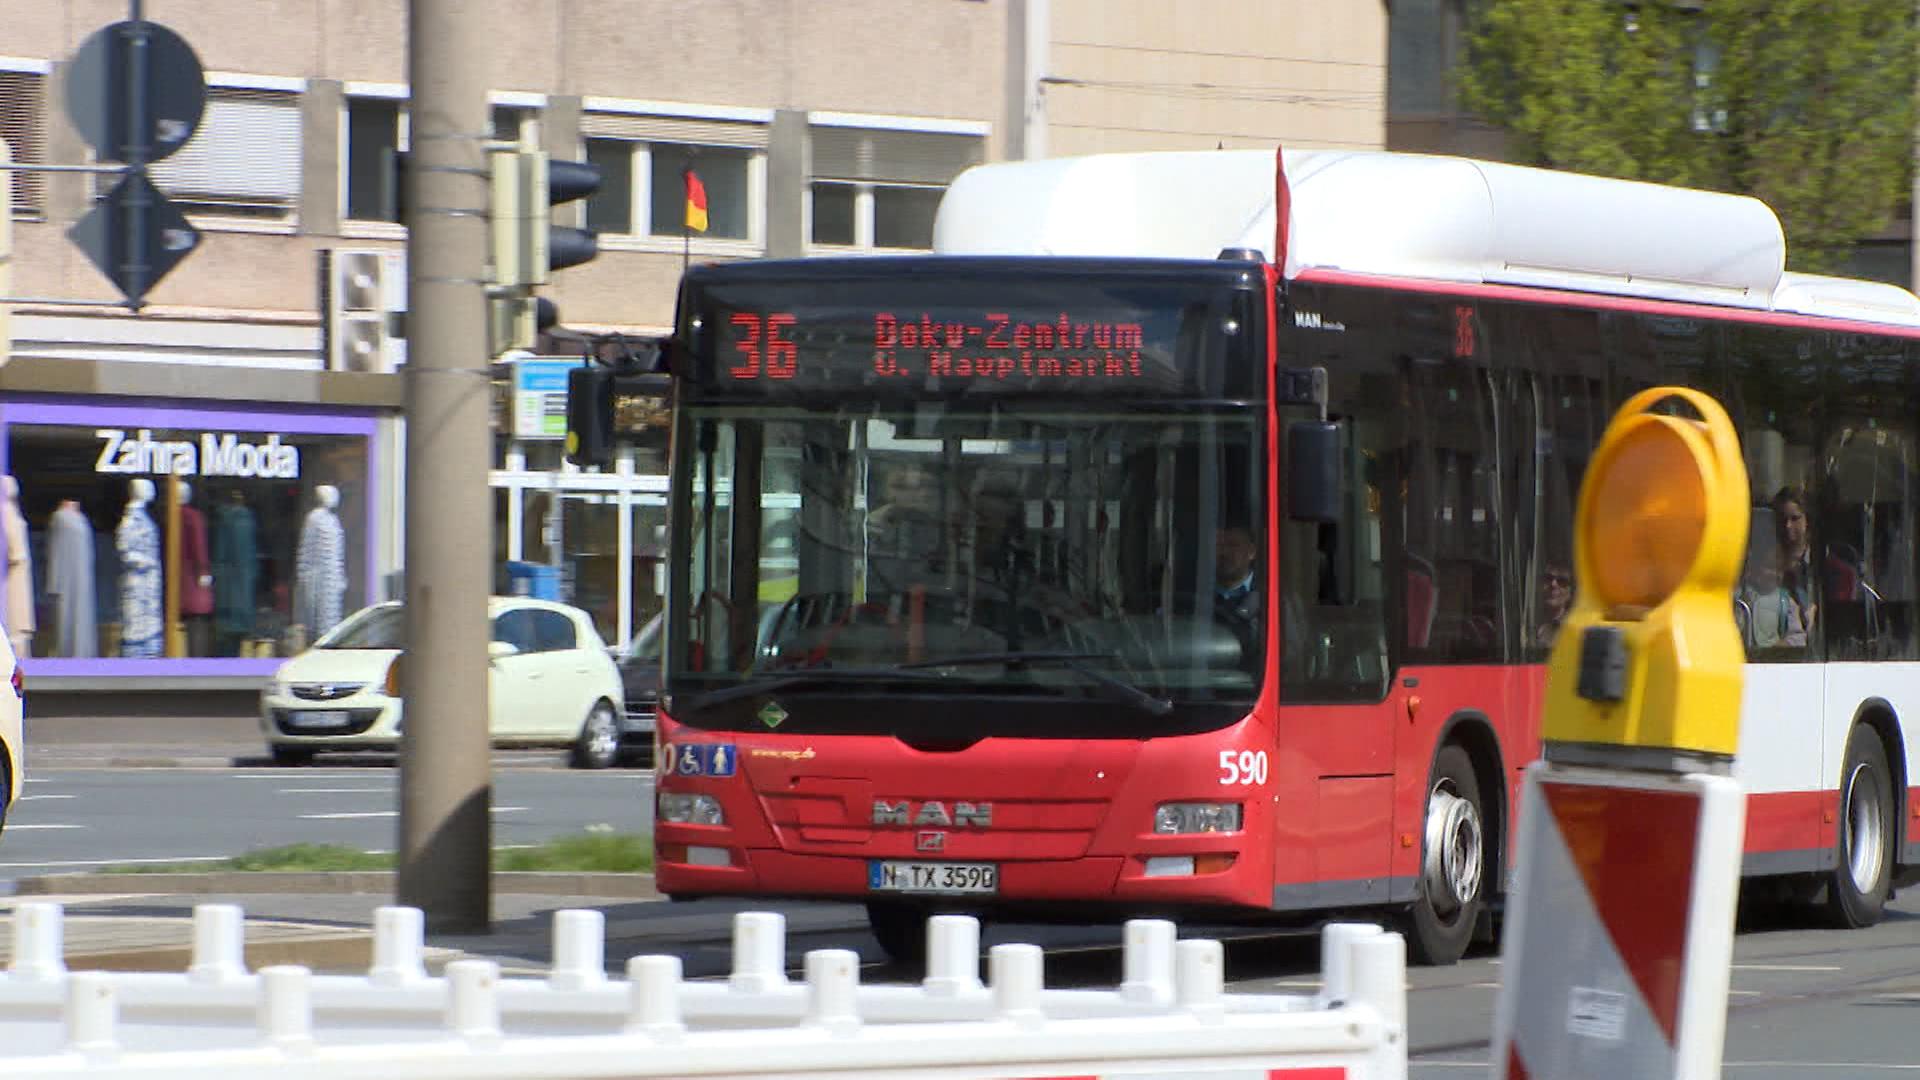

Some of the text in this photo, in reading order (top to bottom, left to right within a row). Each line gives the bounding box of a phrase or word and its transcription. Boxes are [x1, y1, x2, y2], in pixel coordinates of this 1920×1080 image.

[874, 312, 1144, 348] Doku-Zentrum
[1294, 311, 1321, 328] MAN
[729, 312, 798, 379] 36
[95, 429, 299, 478] Zahra Moda
[1219, 750, 1268, 785] 590
[872, 801, 993, 827] MAN
[883, 865, 993, 889] N TX 3590
